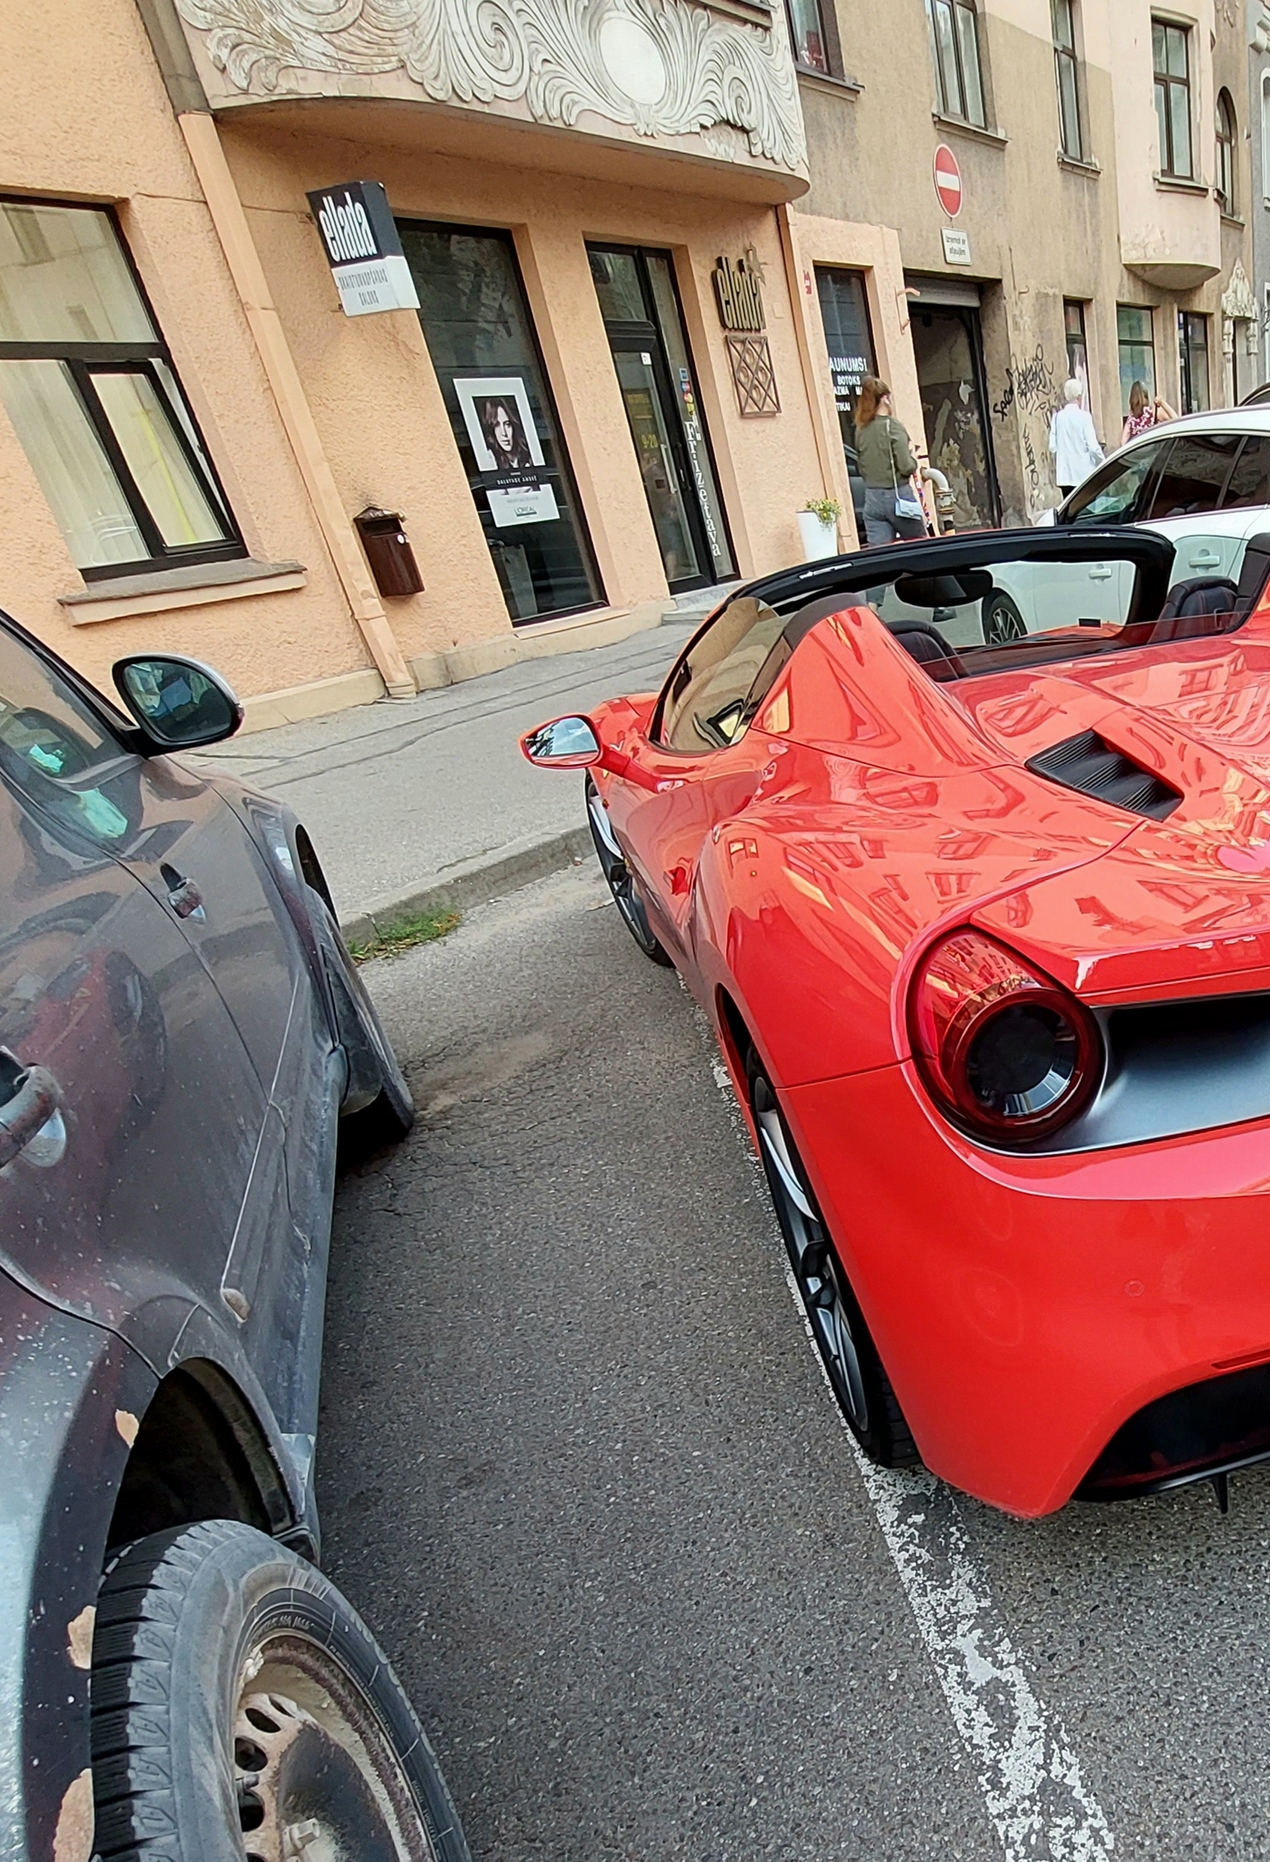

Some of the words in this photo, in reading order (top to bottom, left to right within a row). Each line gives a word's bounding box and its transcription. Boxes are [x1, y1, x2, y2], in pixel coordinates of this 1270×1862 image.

[319, 191, 378, 262] ellada
[713, 256, 766, 331] ellada
[829, 356, 868, 372] AUNUMS!
